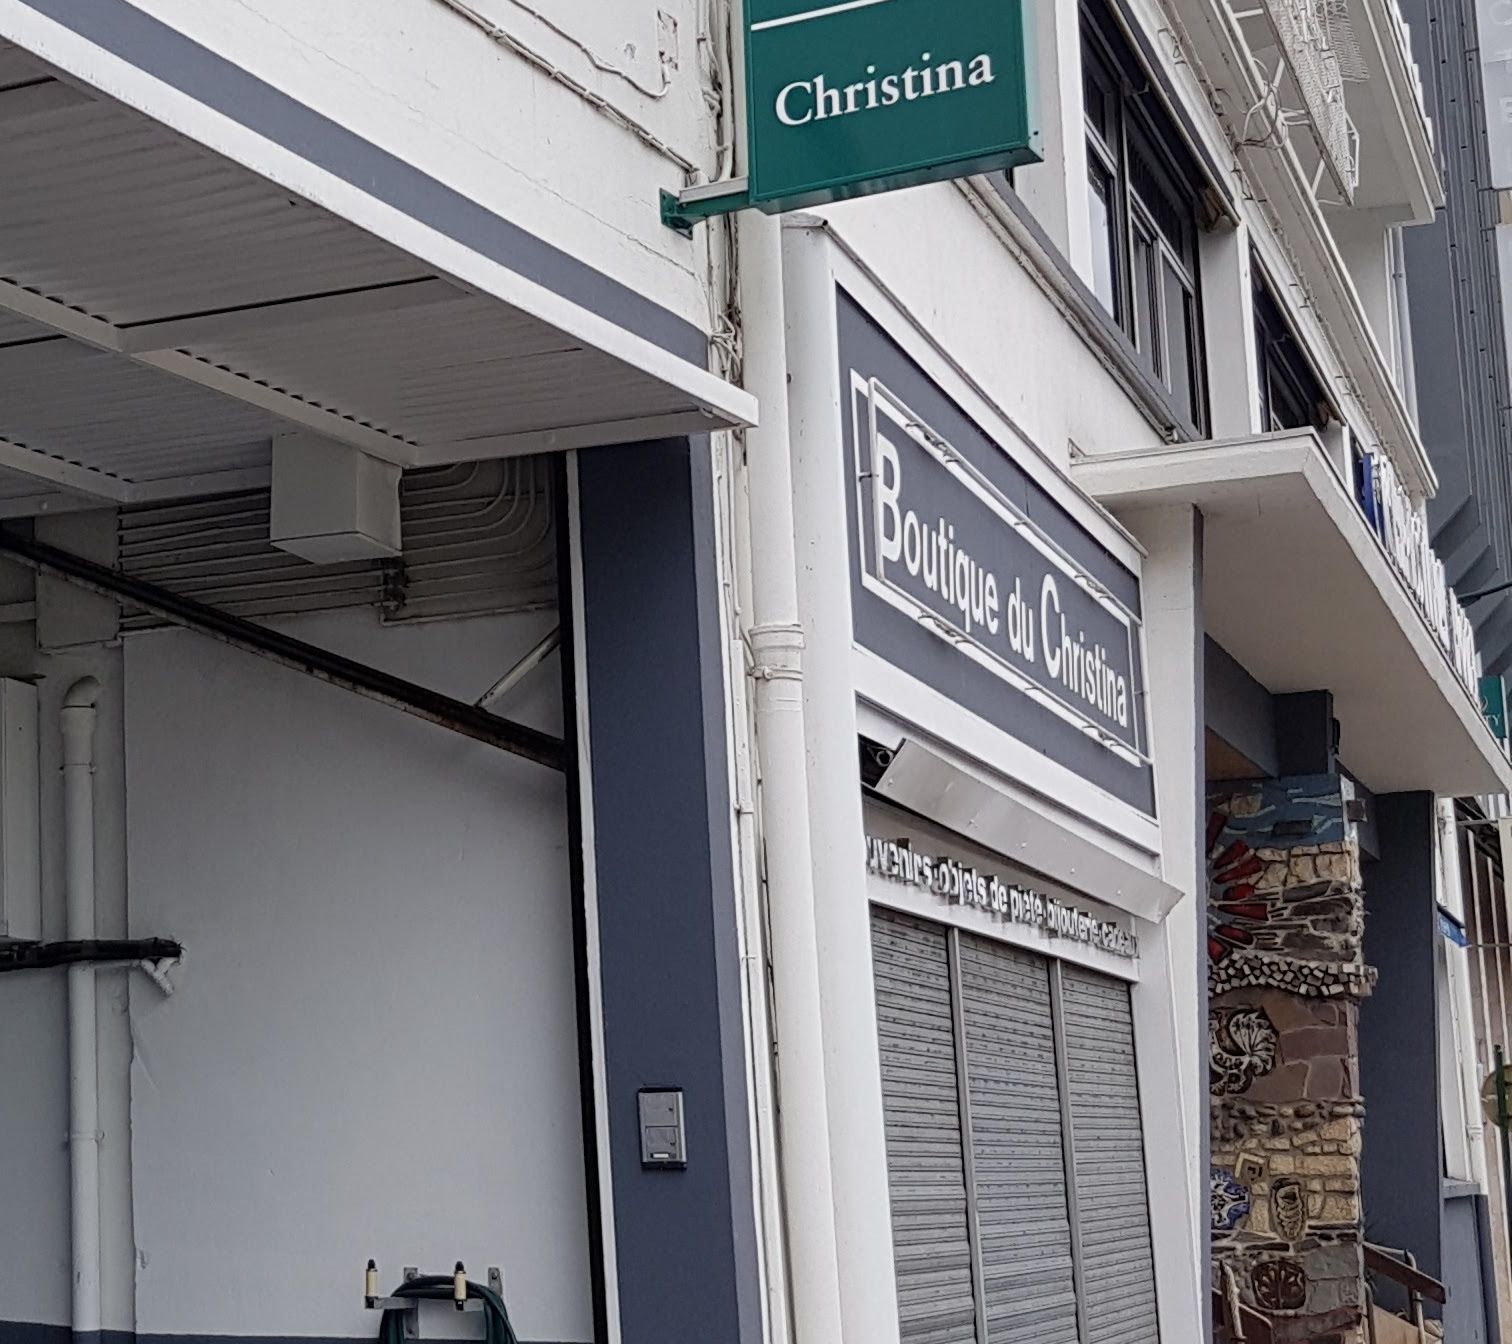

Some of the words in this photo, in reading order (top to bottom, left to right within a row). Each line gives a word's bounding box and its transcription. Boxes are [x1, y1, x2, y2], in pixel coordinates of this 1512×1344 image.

[775, 52, 995, 126] Christina
[875, 433, 999, 635] Boutique
[1007, 577, 1035, 663] du
[1040, 573, 1128, 729] Christina
